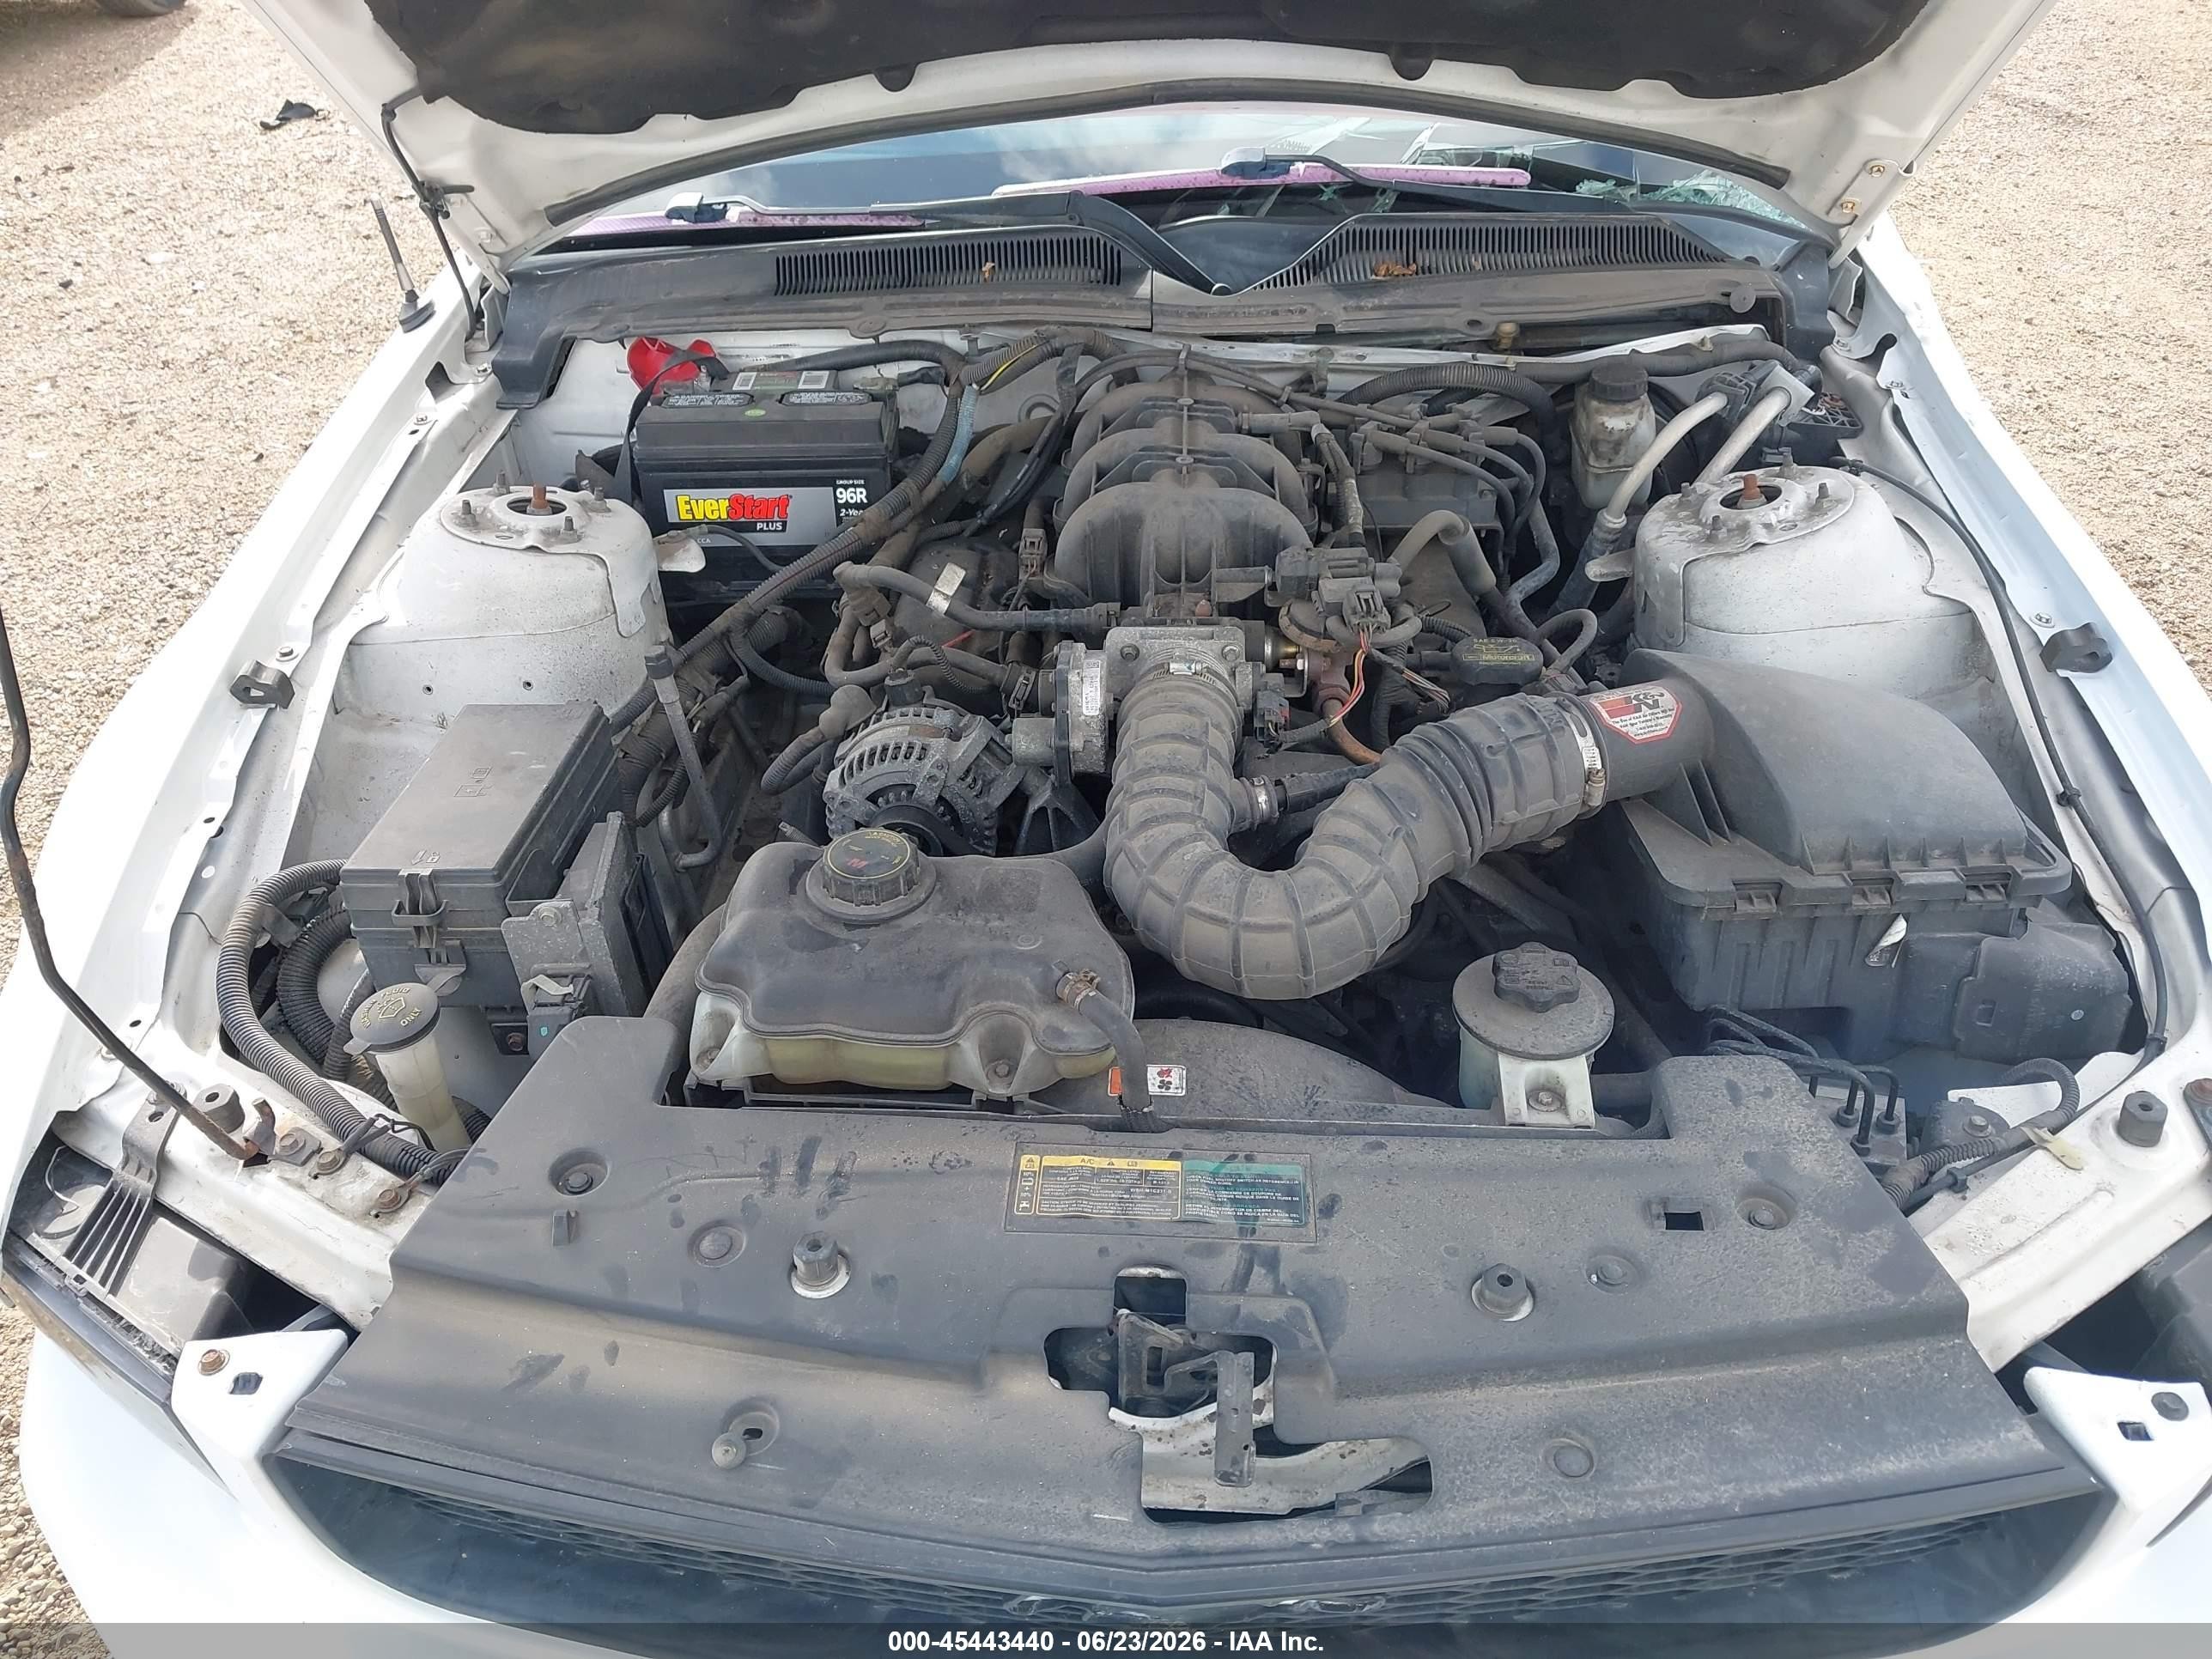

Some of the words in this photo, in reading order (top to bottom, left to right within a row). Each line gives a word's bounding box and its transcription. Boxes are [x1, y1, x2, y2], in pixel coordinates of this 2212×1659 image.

[836, 487, 868, 504] 96R
[676, 493, 790, 521] EverStart
[756, 521, 783, 532] PLUS
[400, 1008, 422, 1026] ONLY
